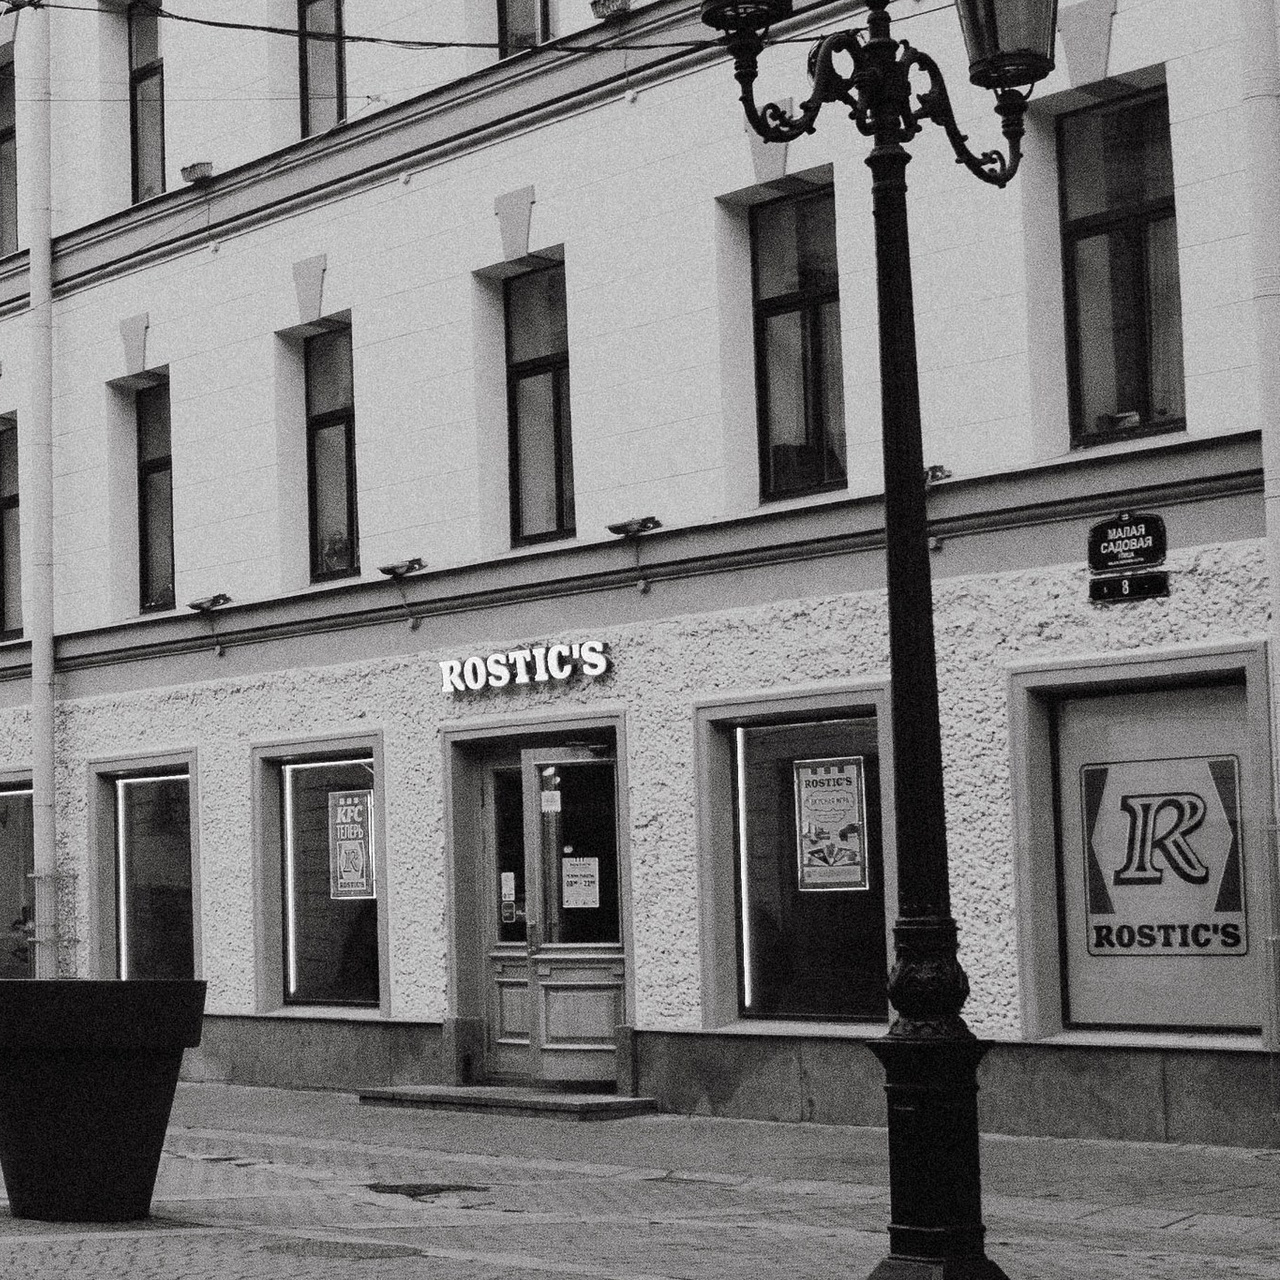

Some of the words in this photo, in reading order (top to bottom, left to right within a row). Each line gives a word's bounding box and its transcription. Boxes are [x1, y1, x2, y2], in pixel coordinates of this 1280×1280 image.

[1107, 524, 1146, 540] МАЛАЯ
[1100, 536, 1153, 554] САДОВАЯ
[1121, 579, 1129, 595] 8
[439, 640, 607, 693] ROSTIC'S
[804, 777, 853, 789] ROSTIC'S
[336, 805, 363, 823] KFC
[336, 824, 364, 839] ТЕПЕРЬ
[1093, 923, 1241, 948] ROSTIC'S
